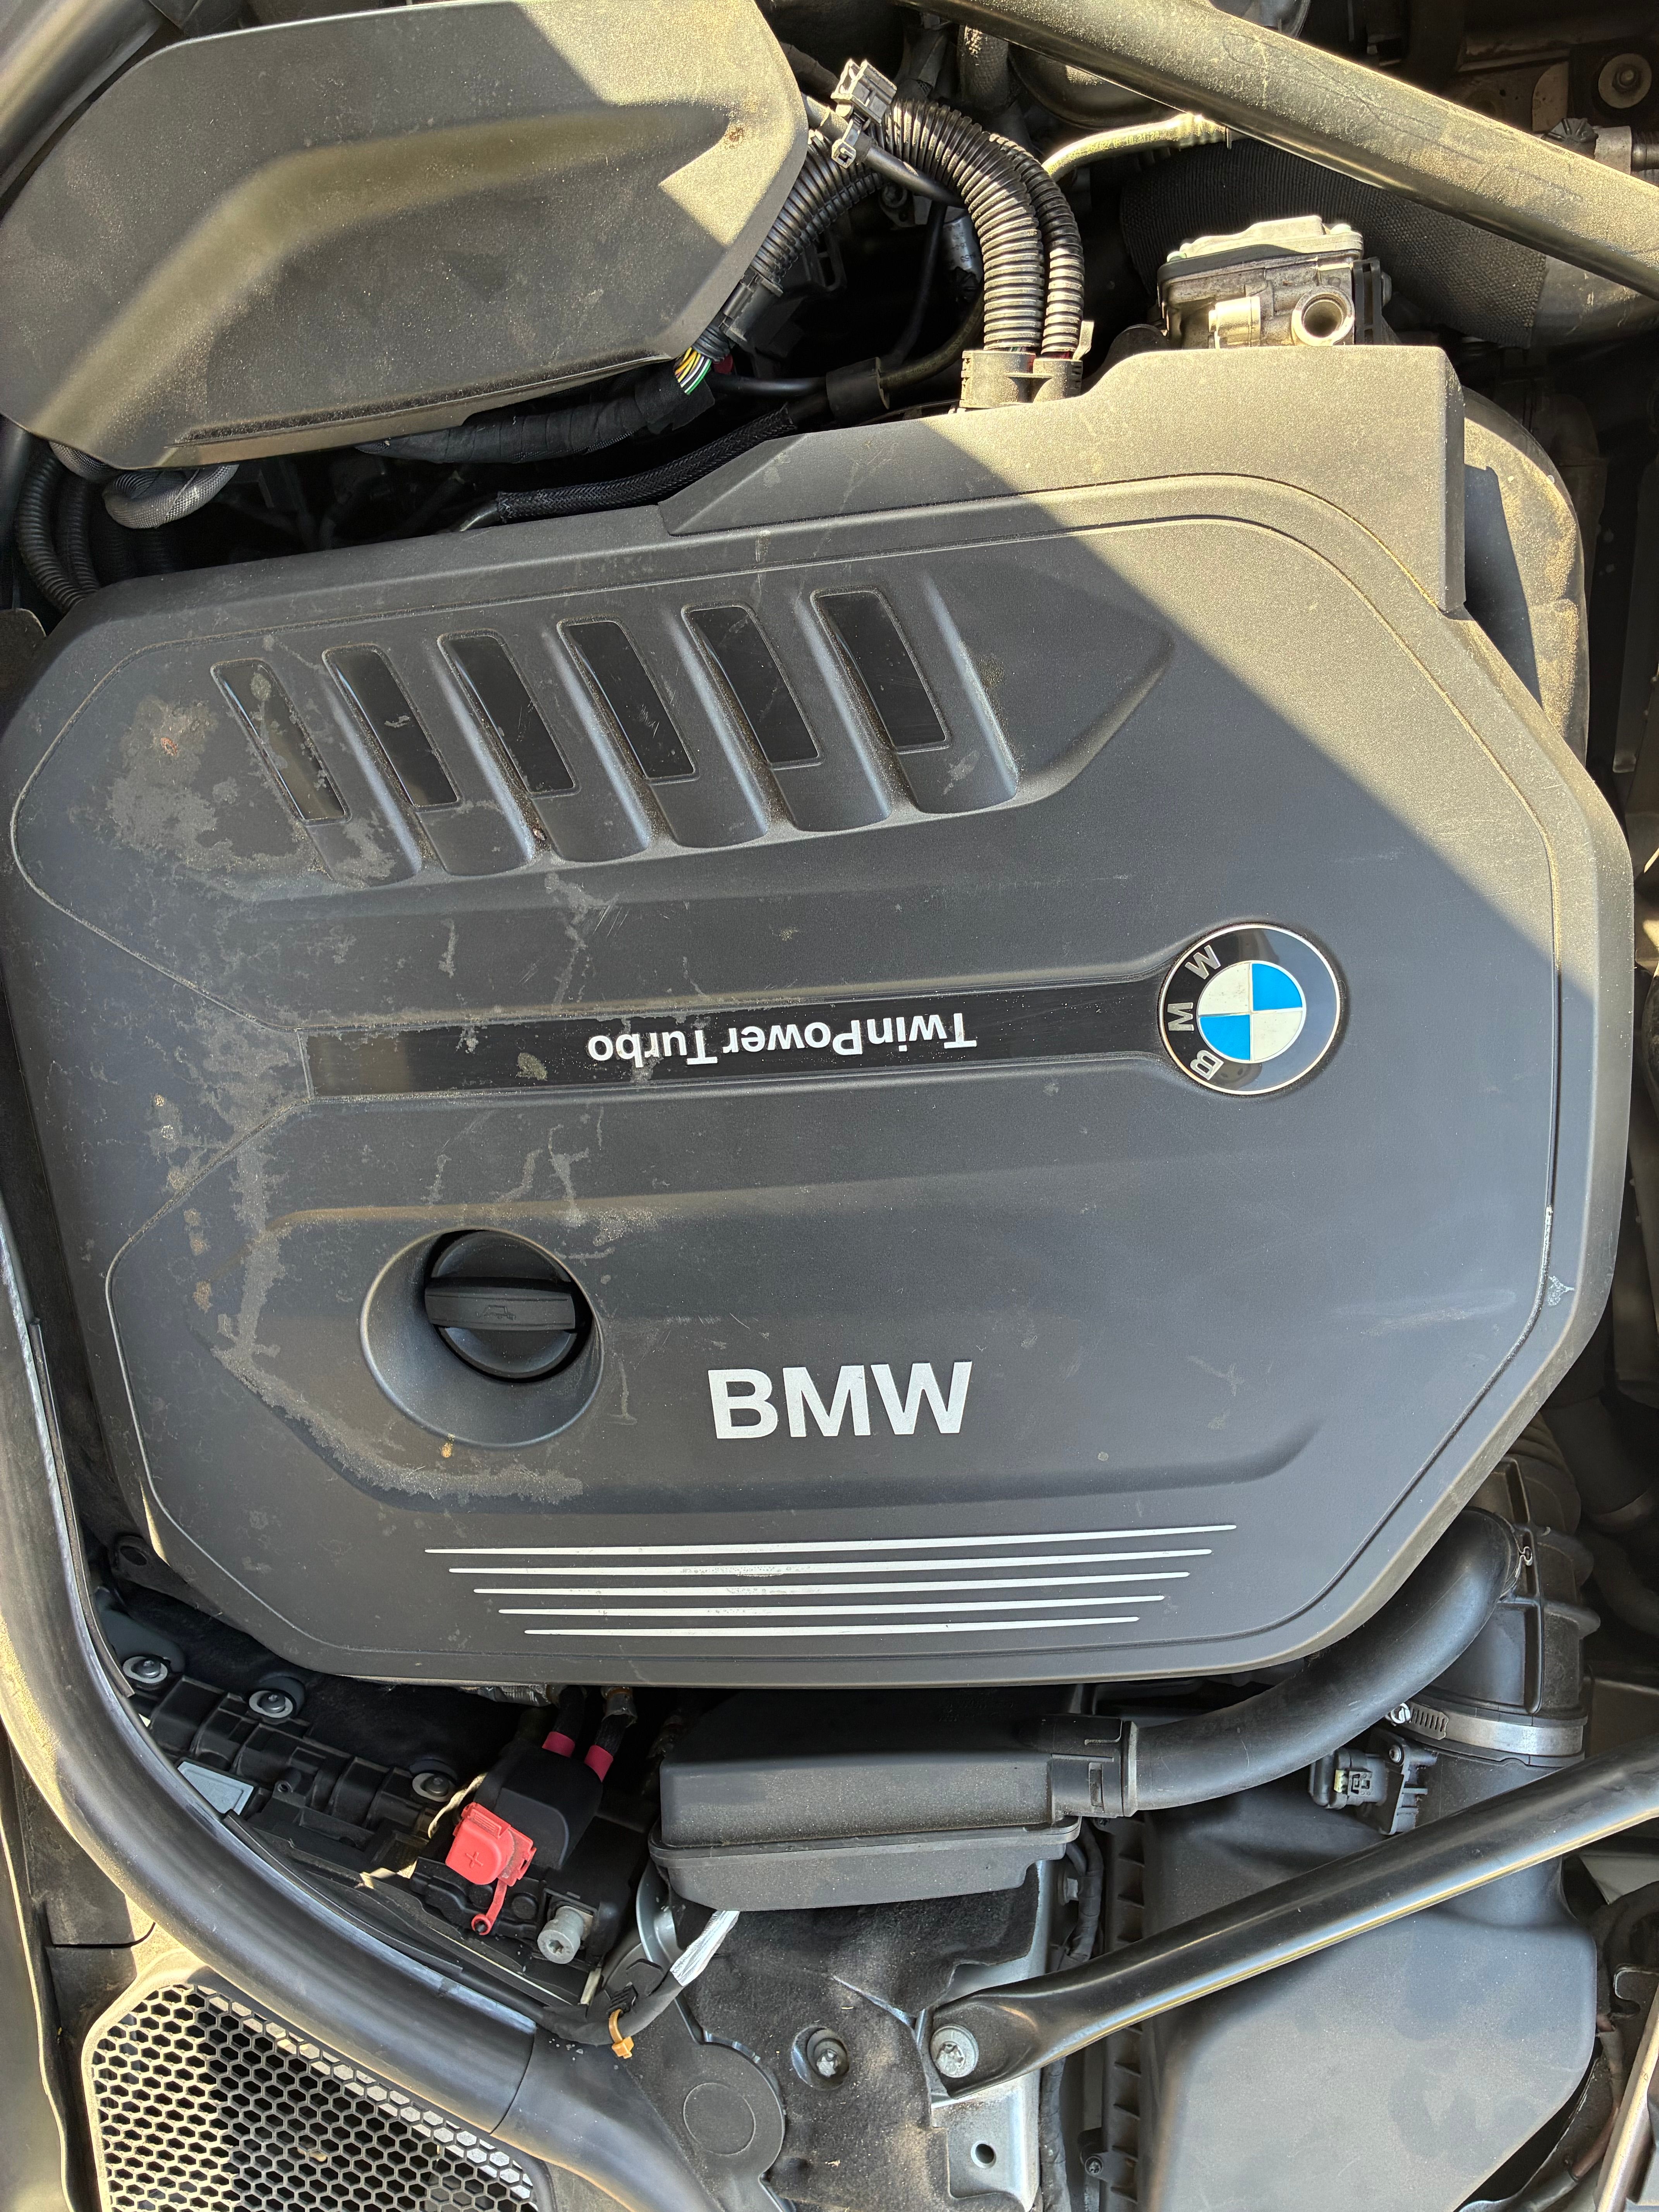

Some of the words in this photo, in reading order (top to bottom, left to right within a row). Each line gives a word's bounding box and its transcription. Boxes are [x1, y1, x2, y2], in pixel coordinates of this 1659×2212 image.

[723, 1013, 977, 1056] TwinPower
[1168, 945, 1224, 1080] BMW
[587, 1029, 718, 1068] Turbo
[708, 1361, 972, 1439] BMW
